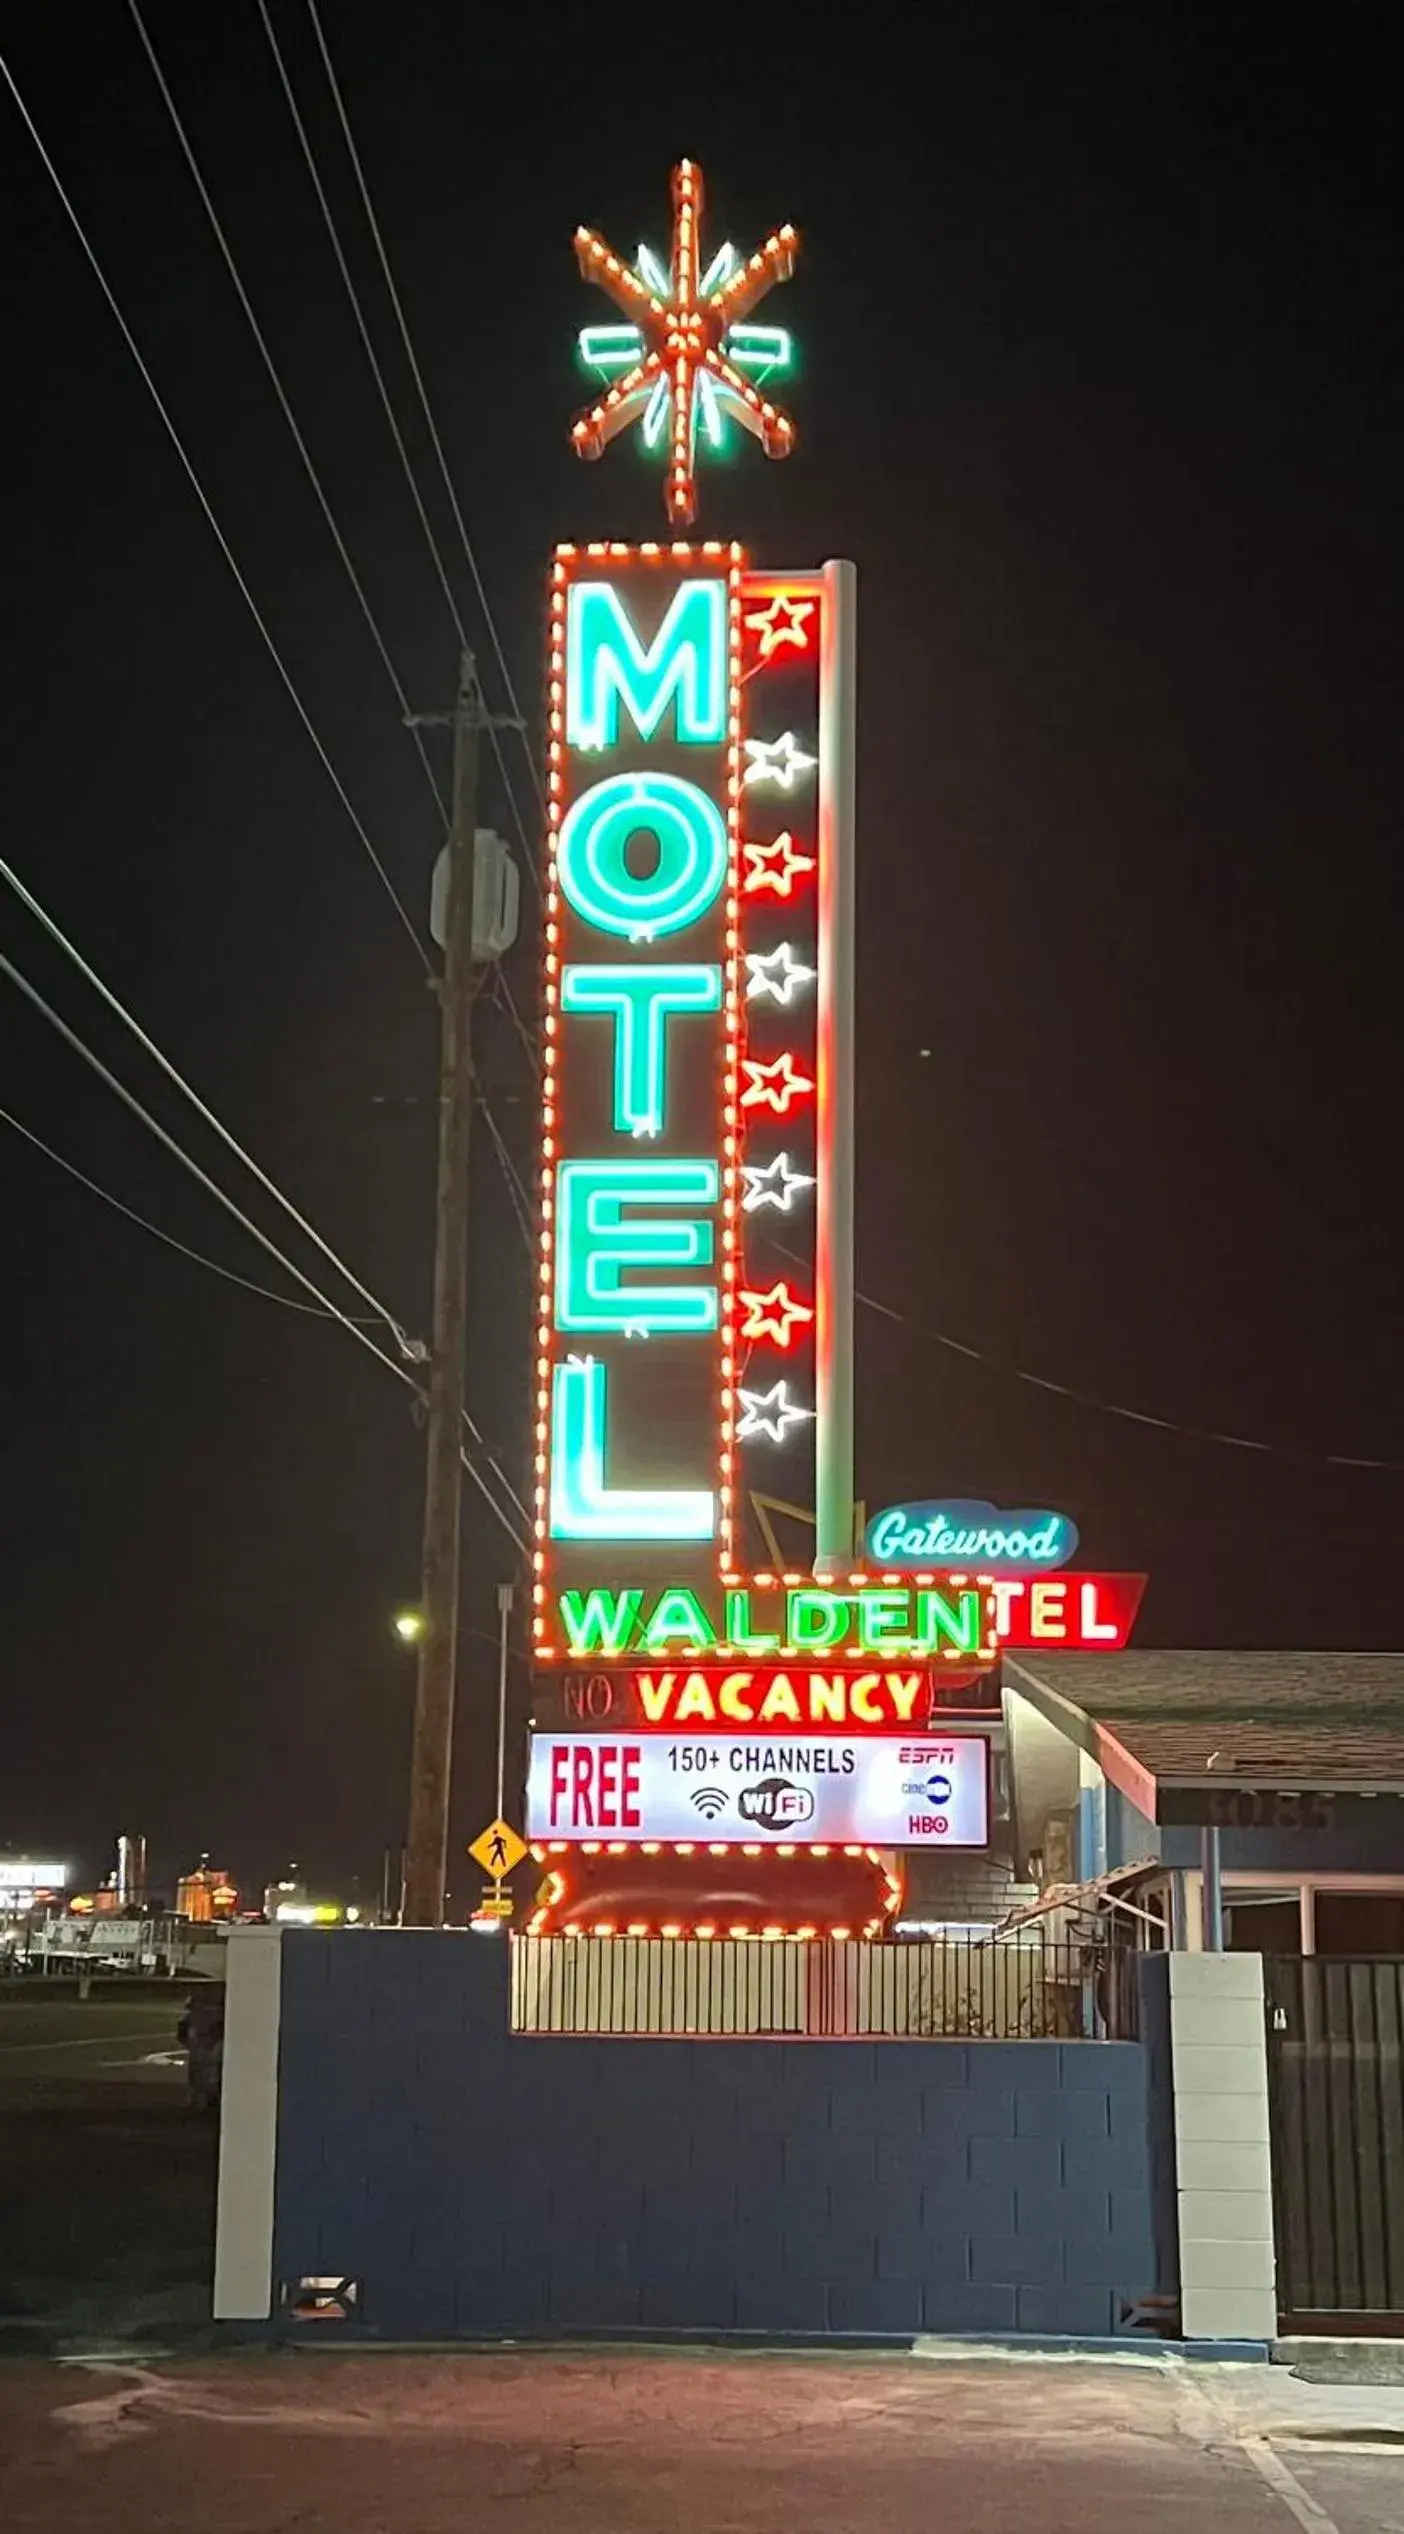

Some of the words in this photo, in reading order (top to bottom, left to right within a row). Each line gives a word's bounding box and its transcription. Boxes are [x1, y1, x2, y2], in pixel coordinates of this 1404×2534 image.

[549, 579, 728, 1542] MOTEL
[872, 1511, 1060, 1560] Gatewood
[559, 1588, 979, 1652] WALDEN
[994, 1582, 1118, 1639] TEL
[565, 1676, 612, 1719] NO
[637, 1673, 921, 1721] VACANCY
[667, 1747, 721, 1772] 150+
[729, 1748, 855, 1774] CHANNELS
[898, 1747, 955, 1765] ESPN
[549, 1745, 642, 1827] FREE
[909, 1814, 949, 1834] HBO
